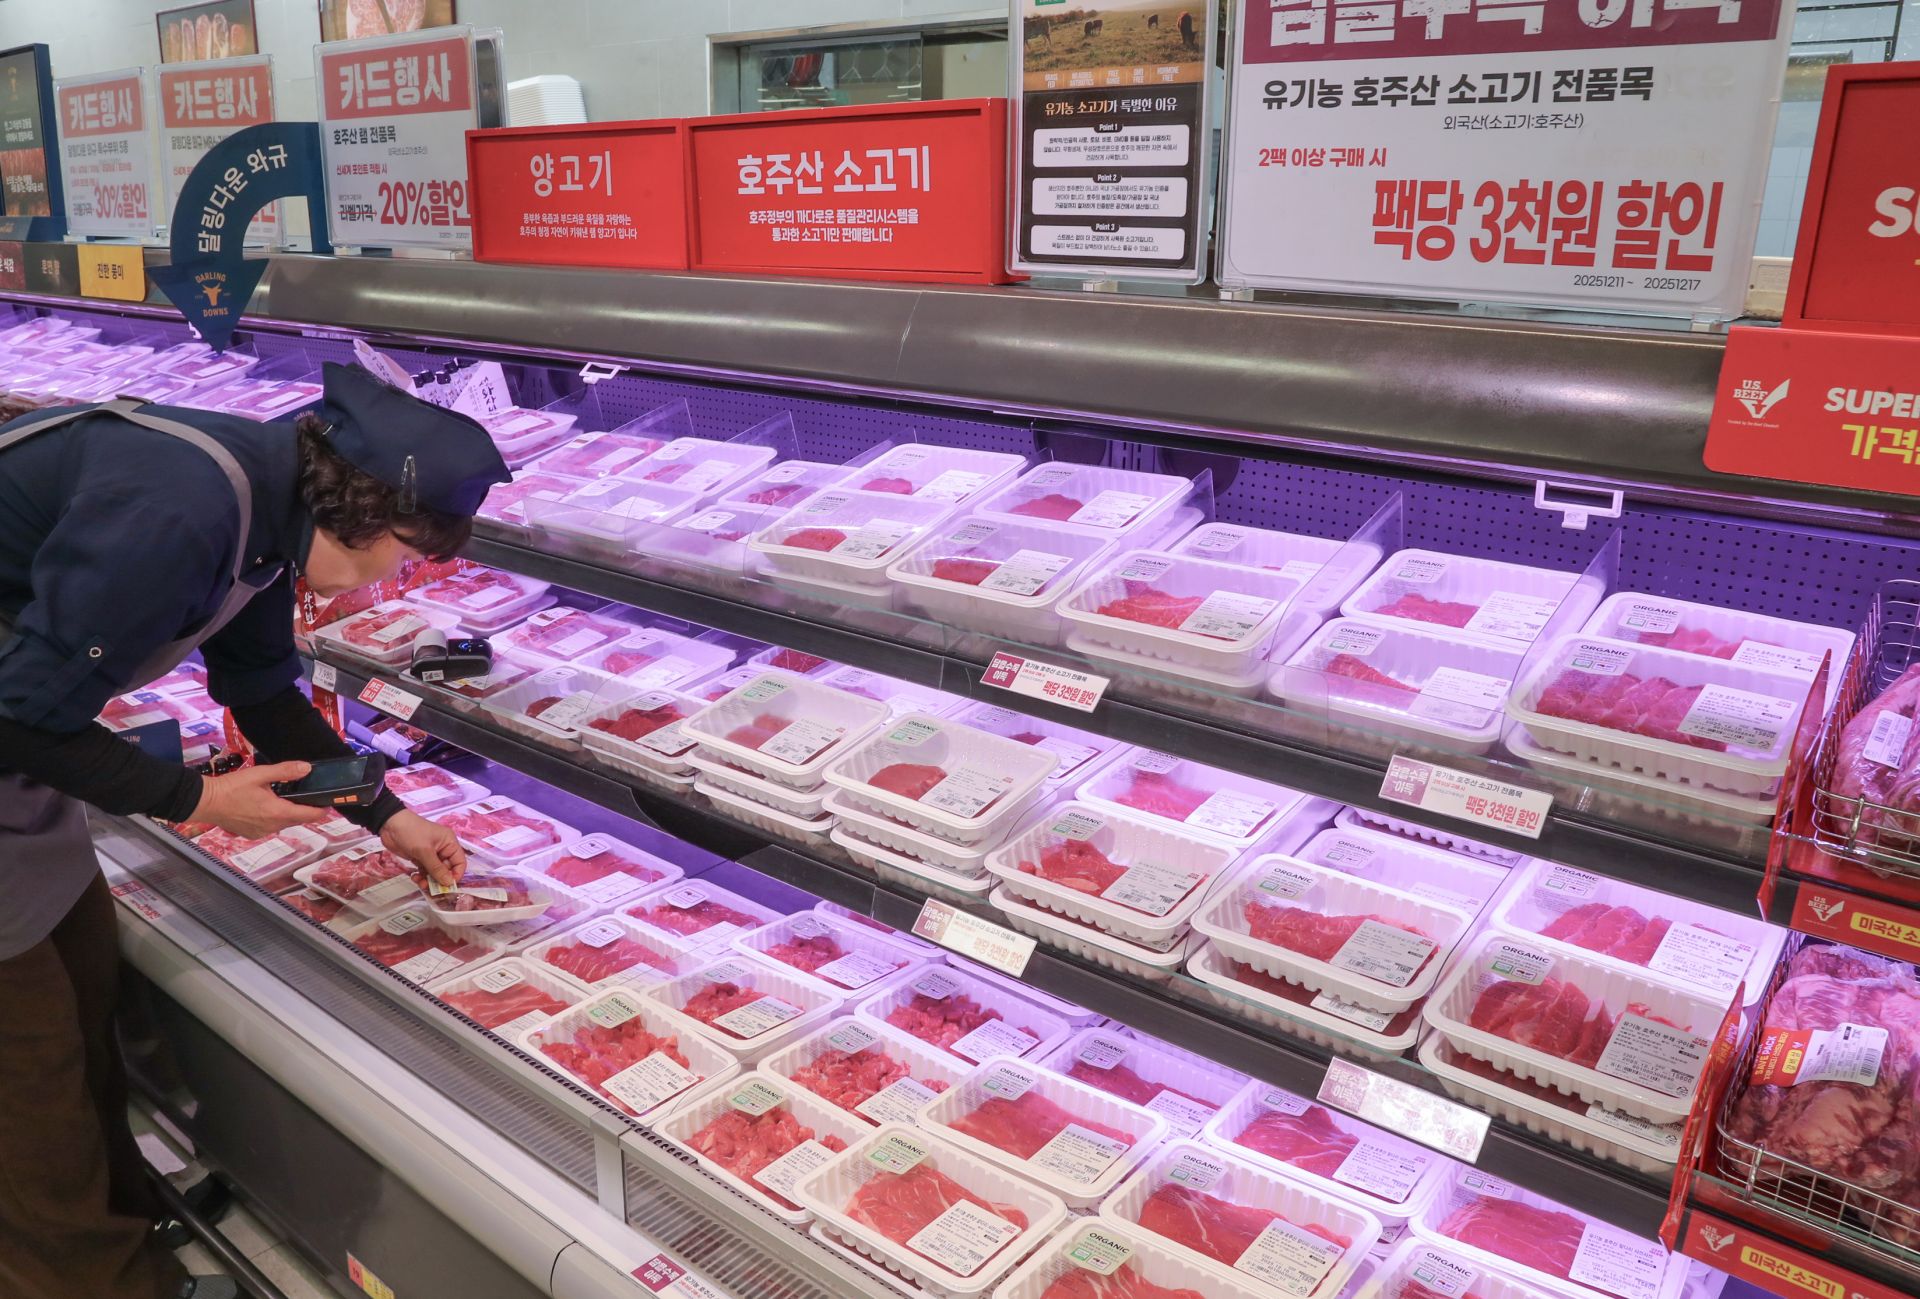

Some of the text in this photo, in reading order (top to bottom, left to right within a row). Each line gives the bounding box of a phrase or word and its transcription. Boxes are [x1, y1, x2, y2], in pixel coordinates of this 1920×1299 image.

[339, 52, 451, 110] 카드행사
[1262, 66, 1654, 110] 유기농 호주산 소고기 전품목
[173, 76, 258, 120] 카드행사
[1045, 98, 1178, 115] 유기농 소고기가 특별한 이유
[68, 88, 133, 130] 카드행사
[1444, 113, 1584, 131] 외국산(소고기:호주산)
[334, 126, 395, 145] 호주산 램 전품목
[1259, 148, 1387, 167] 2팩 이상 구매 시
[352, 164, 368, 175] 포인트
[370, 163, 380, 174] 적립
[382, 163, 387, 174] 시
[530, 150, 612, 197] 양고기
[737, 146, 930, 195] 호주산 소고기
[95, 182, 147, 218] 30%할인
[198, 167, 248, 252] 달링다운
[246, 144, 288, 174] 와규
[378, 180, 472, 226] 20%할인
[523, 213, 631, 225] 풍부한 육즙과 부드러운 육질을 자랑하는
[749, 209, 919, 225] 호주정부의 까다로운 품질관리시스템을
[1867, 186, 1920, 238] S
[520, 226, 637, 239] 호주의 청정 자연이 키워낸 램 양고기 입니다
[1373, 179, 1724, 272] 팩당 3천원 할인
[772, 228, 893, 243] 통과한 소고기만 판매합니다
[195, 272, 226, 283] DARLING
[1644, 277, 1701, 291] 20251217
[203, 308, 228, 317] DOWNS
[1743, 380, 1761, 390] U.S.
[1733, 389, 1769, 400] BEEF
[1842, 424, 1920, 465] 가격
[1407, 558, 1446, 569] ORGANIC
[1633, 604, 1678, 616] ORGANIC
[1340, 628, 1381, 639] ORGANIC
[1580, 643, 1630, 658] ORGANIC
[1025, 663, 1088, 682] 유기농 호주산 소고기 전품목
[1043, 681, 1097, 706] 팩당 3천원 할인
[908, 720, 939, 734] ORGANIC
[1390, 765, 1429, 785] 담을수록
[1435, 770, 1523, 798] 유기농 호주산 소고기 전품목
[1394, 781, 1415, 796] 이득
[1068, 812, 1104, 826] ORGANIC
[1466, 795, 1540, 830] 팩당 3천원 할인
[1337, 839, 1376, 855] ORGANIC
[1274, 867, 1314, 884] ORGANIC
[1554, 866, 1599, 882] ORGANIC
[1808, 900, 1830, 911] BEEF
[924, 921, 938, 933] 이득
[1859, 917, 1902, 938] 미국산
[1502, 945, 1551, 964] ORGANIC
[932, 972, 959, 989] ORGANIC
[611, 997, 636, 1015] ORGANIC
[848, 1024, 876, 1042] ORGANIC
[1623, 1021, 1642, 1033] 유기농
[1643, 1027, 1661, 1037] 호주산
[1678, 1040, 1695, 1049] 구이용
[1093, 1038, 1125, 1055] ORGANIC
[1762, 1036, 1777, 1055] PACK
[1000, 1066, 1032, 1084] ORGANIC
[752, 1083, 783, 1101] ORGANIC
[890, 1136, 926, 1156] ORGANIC
[1183, 1154, 1223, 1173] ORGANIC
[1089, 1232, 1130, 1255] ORGANIC
[1700, 1229, 1721, 1241] BEEF
[648, 1258, 679, 1281] 담을수록
[1427, 1252, 1473, 1278] ORGANIC
[1749, 1251, 1790, 1278] 미국산
[1792, 1267, 1836, 1296] 소고기
[644, 1270, 663, 1284] 이득
[685, 1276, 699, 1288] 유기농
